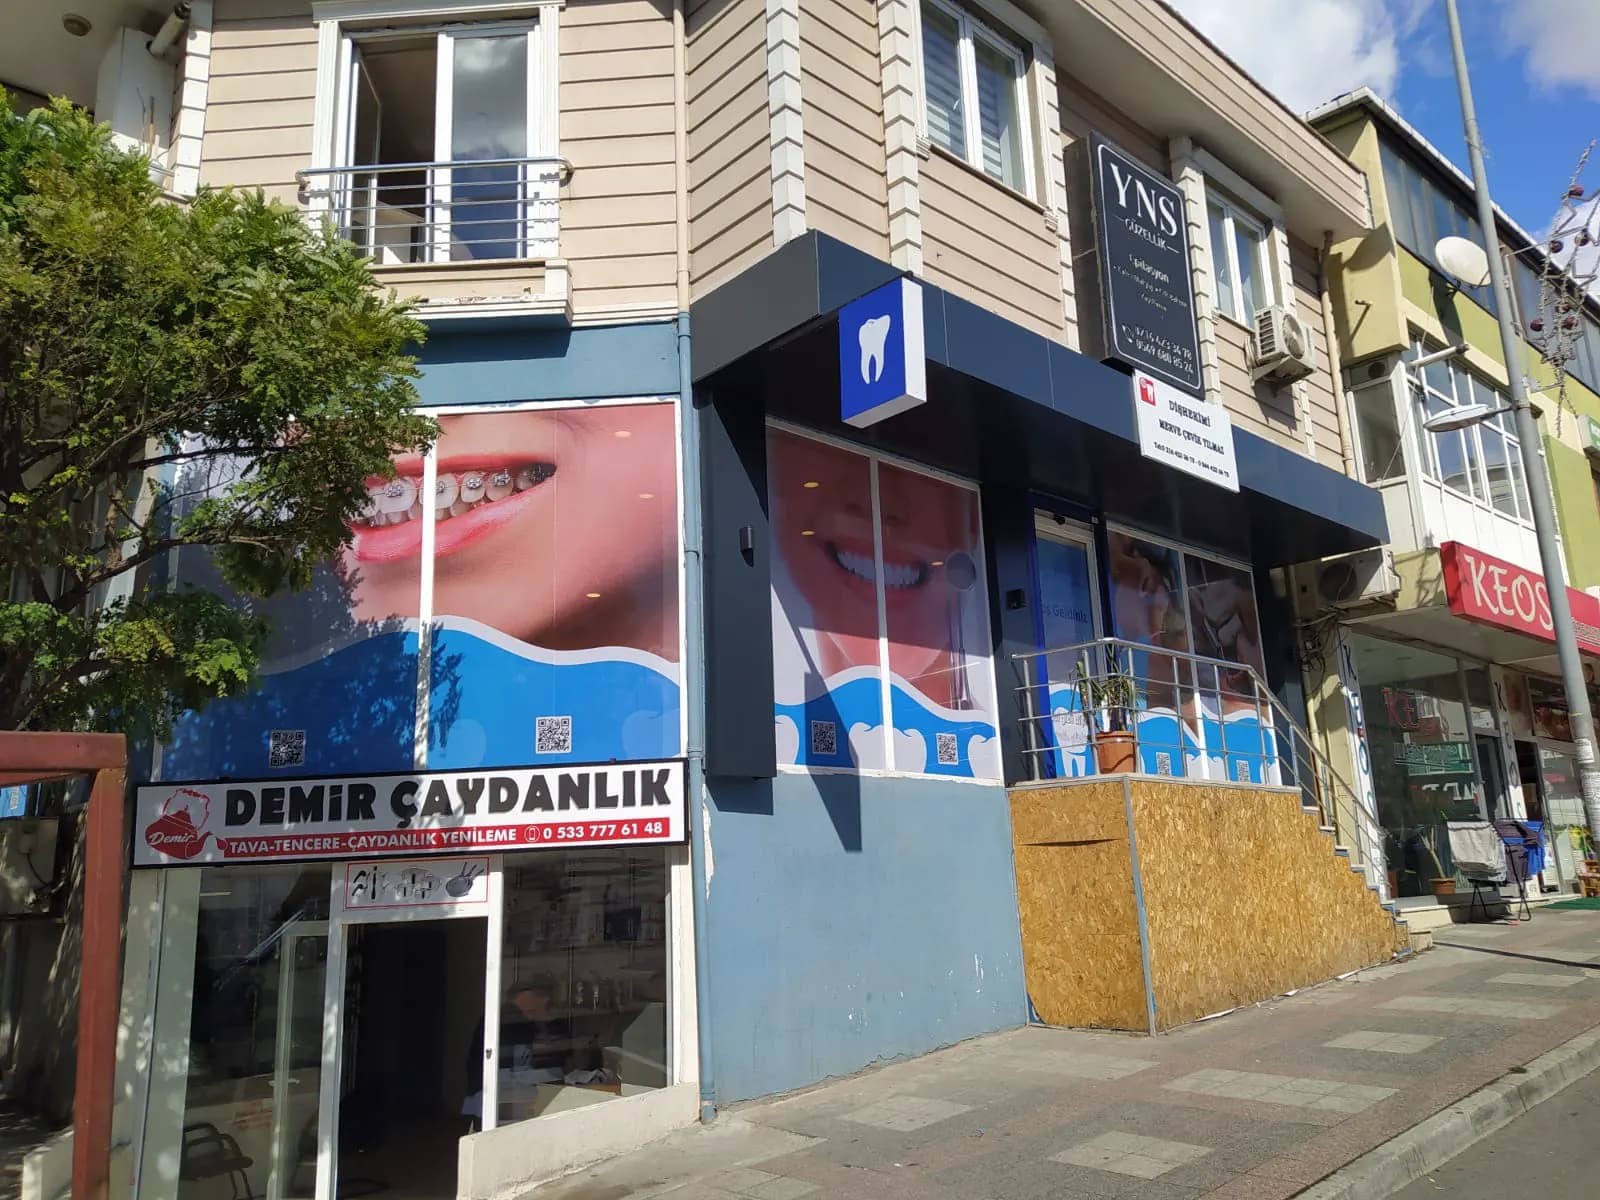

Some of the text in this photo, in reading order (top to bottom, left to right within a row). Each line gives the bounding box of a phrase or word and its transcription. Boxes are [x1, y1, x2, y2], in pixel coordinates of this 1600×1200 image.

[1110, 162, 1177, 236] YNS
[1158, 418, 1182, 437] MERVE
[1464, 553, 1554, 631] KEOS
[390, 768, 672, 829] ÇAYDANLIK
[149, 832, 194, 846] Demir
[230, 827, 517, 854] TAVA-TENCERE-ÇAYDANLIK YENİLEME
[543, 820, 663, 839] 0 533 777 61 48
